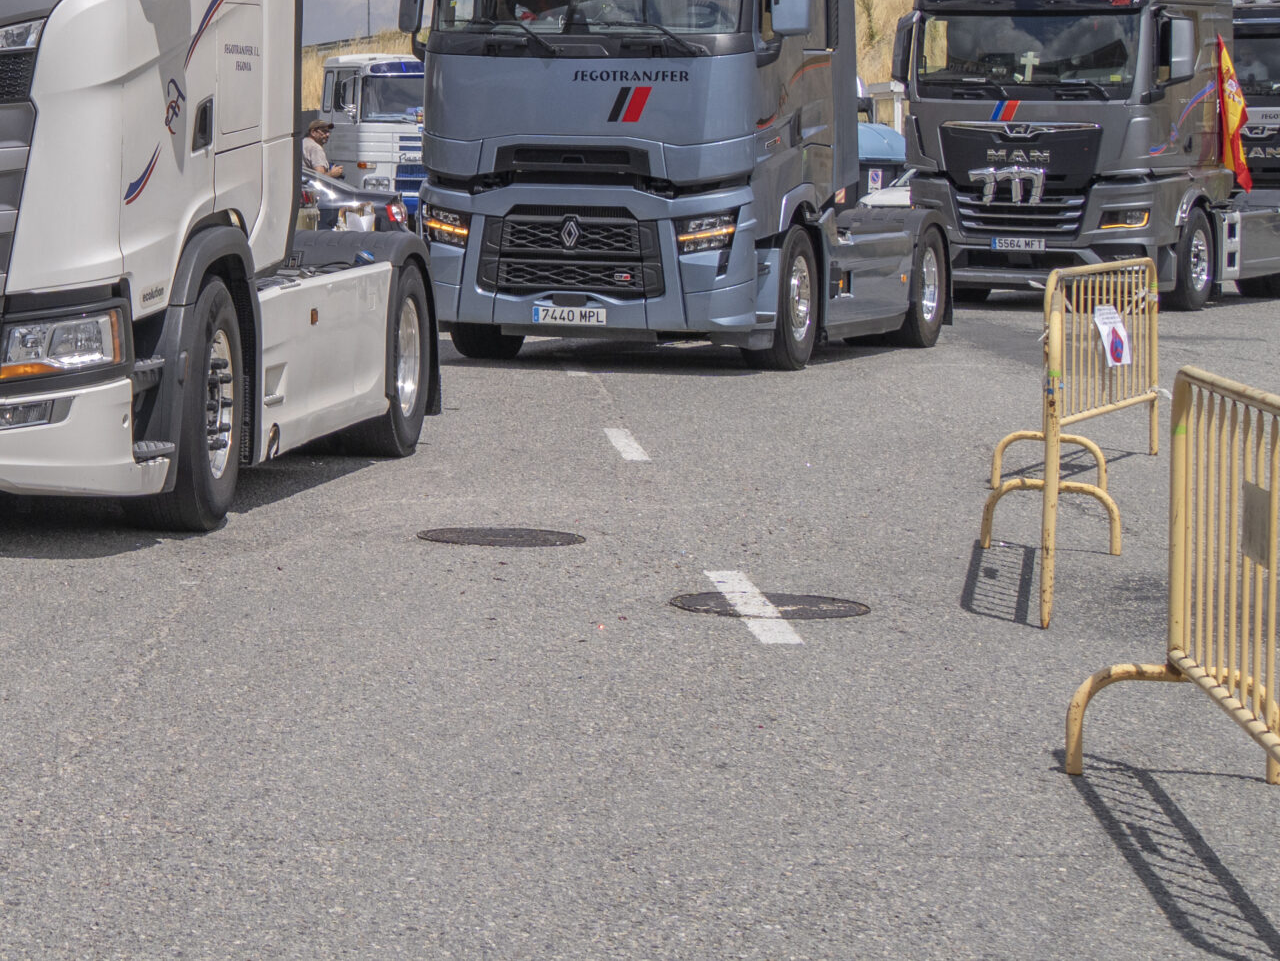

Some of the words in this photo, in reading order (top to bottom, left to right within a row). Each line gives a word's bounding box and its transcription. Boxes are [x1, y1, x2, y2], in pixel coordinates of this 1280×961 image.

[572, 70, 689, 82] SEGOTRANSFER
[986, 149, 1050, 163] MAN
[1243, 147, 1280, 158] AN
[998, 239, 1021, 249] 5564
[1024, 239, 1043, 249] MFT
[542, 308, 575, 322] 7440
[579, 310, 604, 323] MPL
